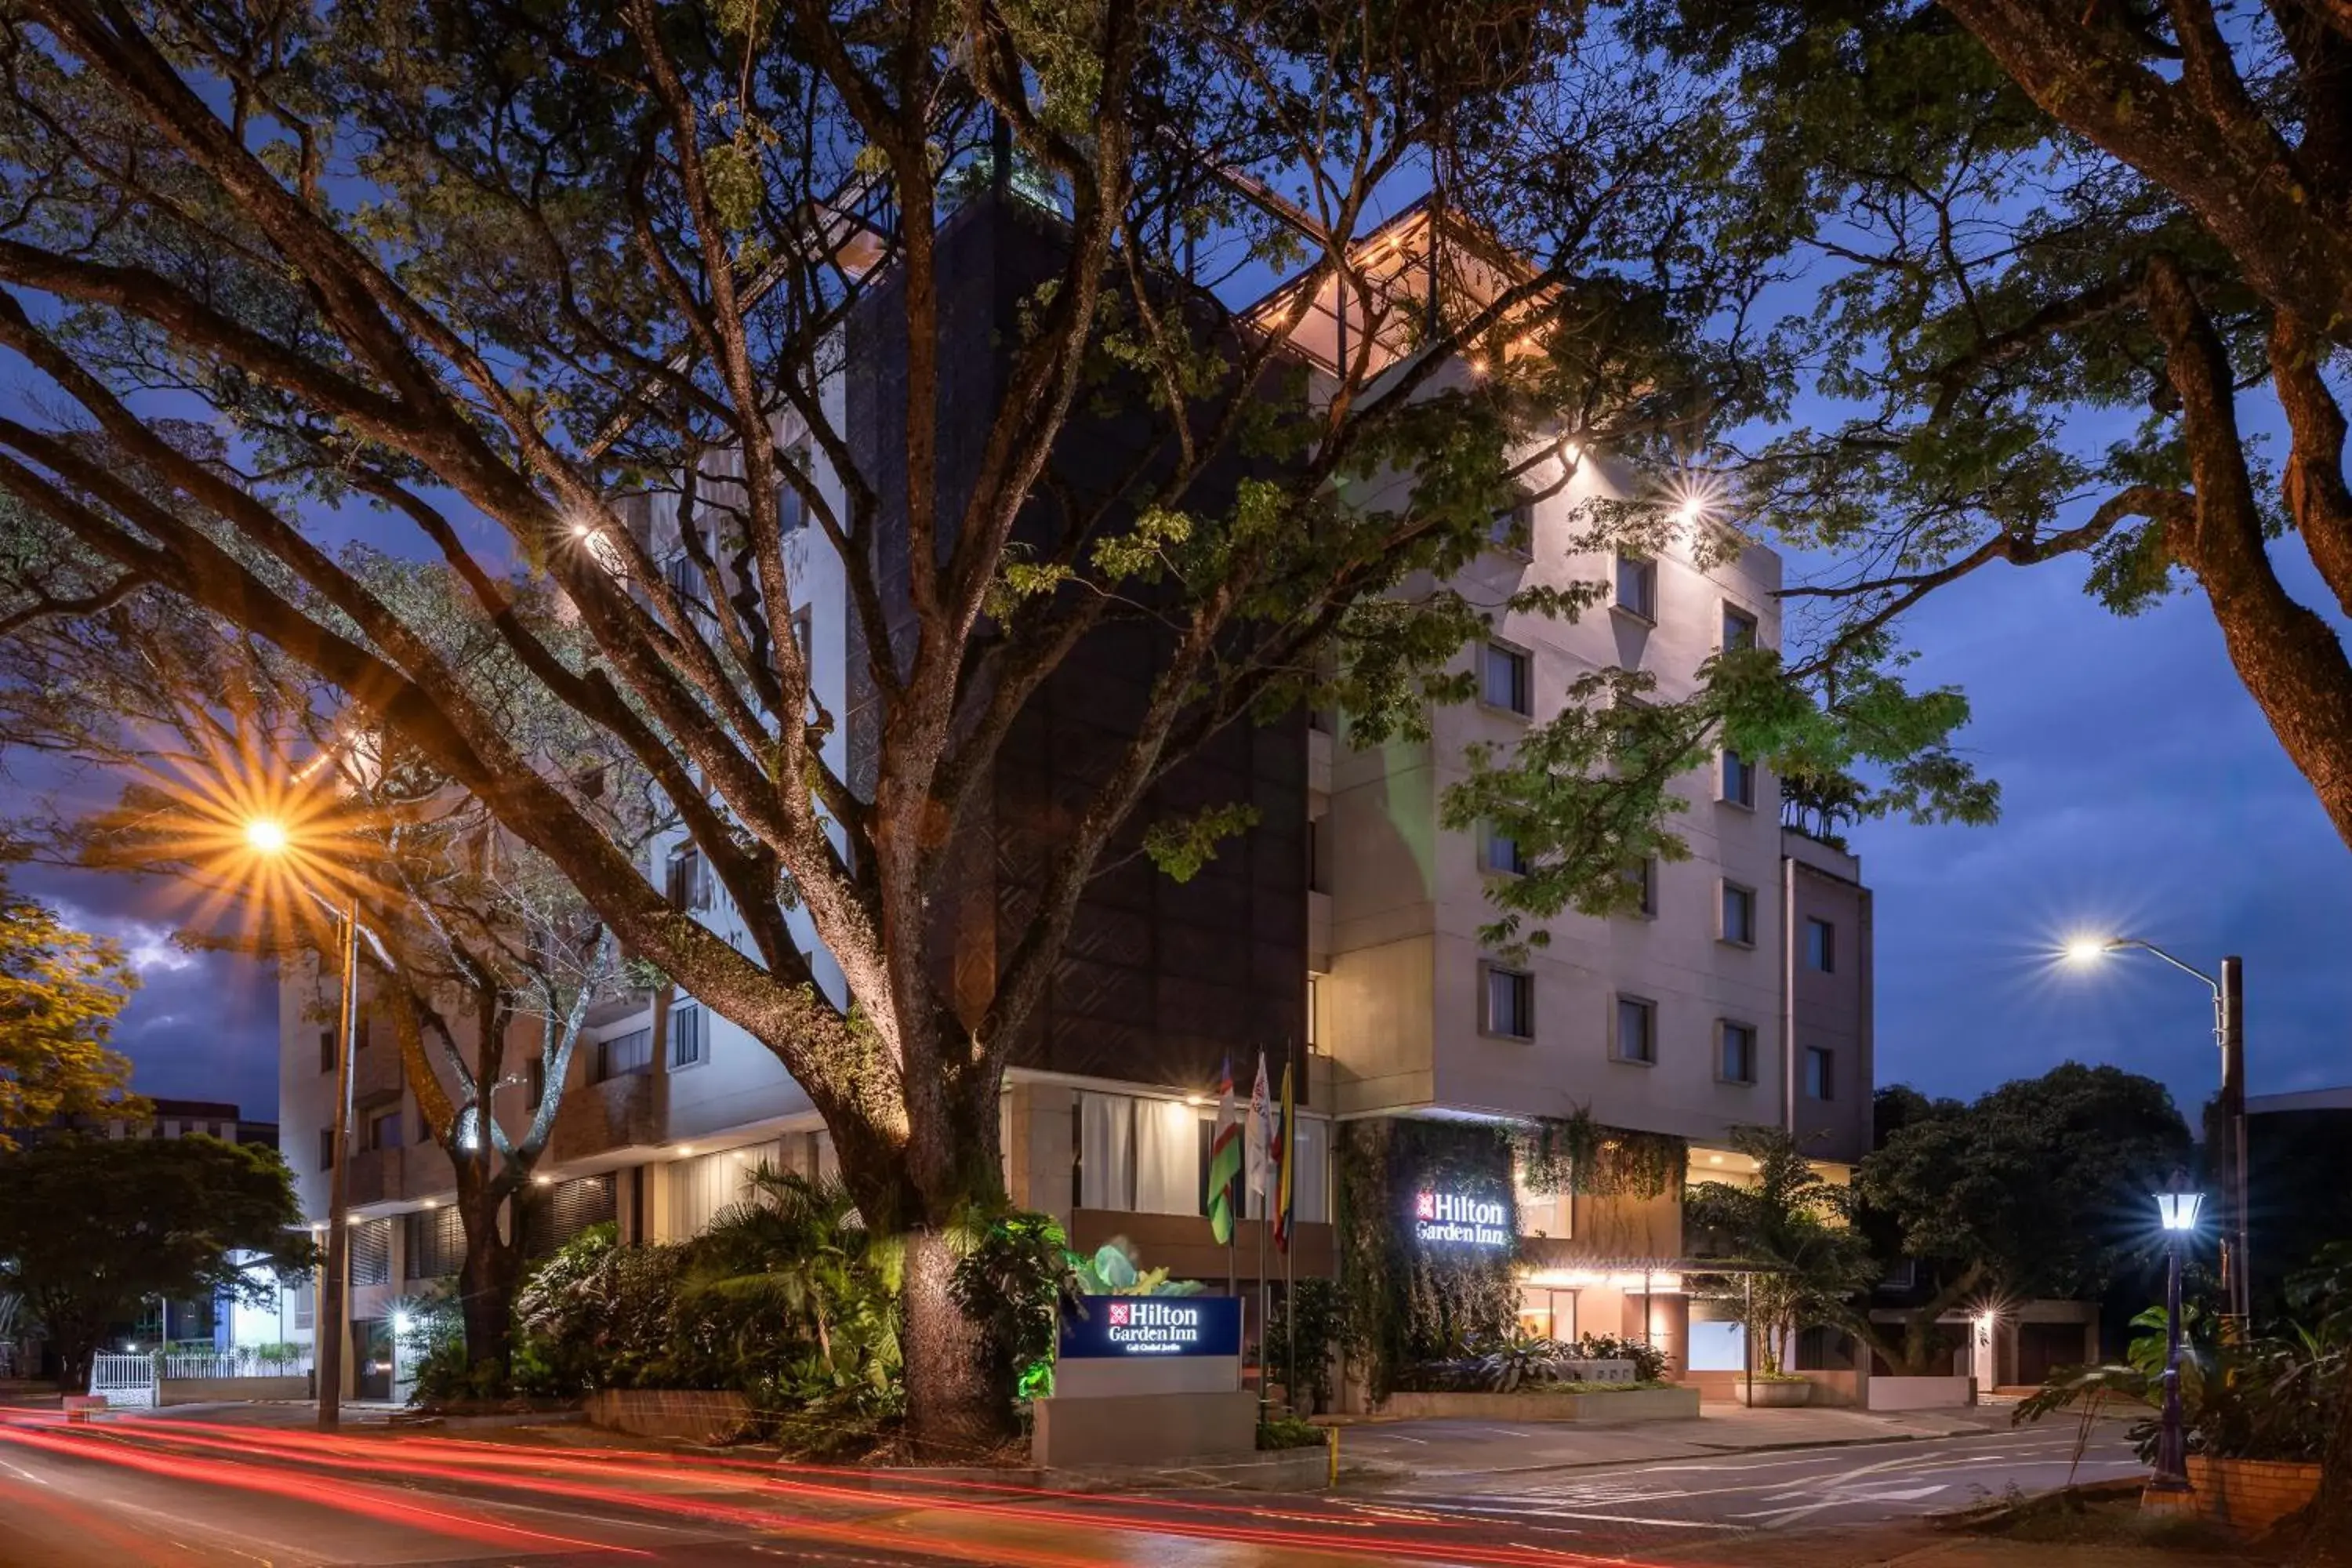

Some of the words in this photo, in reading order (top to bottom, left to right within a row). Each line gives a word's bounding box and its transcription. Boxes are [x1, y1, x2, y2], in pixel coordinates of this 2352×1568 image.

[1435, 1194, 1504, 1225] Hilton
[1416, 1221, 1473, 1243] Garden
[1475, 1224, 1504, 1245] Inn
[1130, 1304, 1197, 1326] Hilton
[1109, 1326, 1167, 1341] Garden
[1169, 1327, 1197, 1341] Inn
